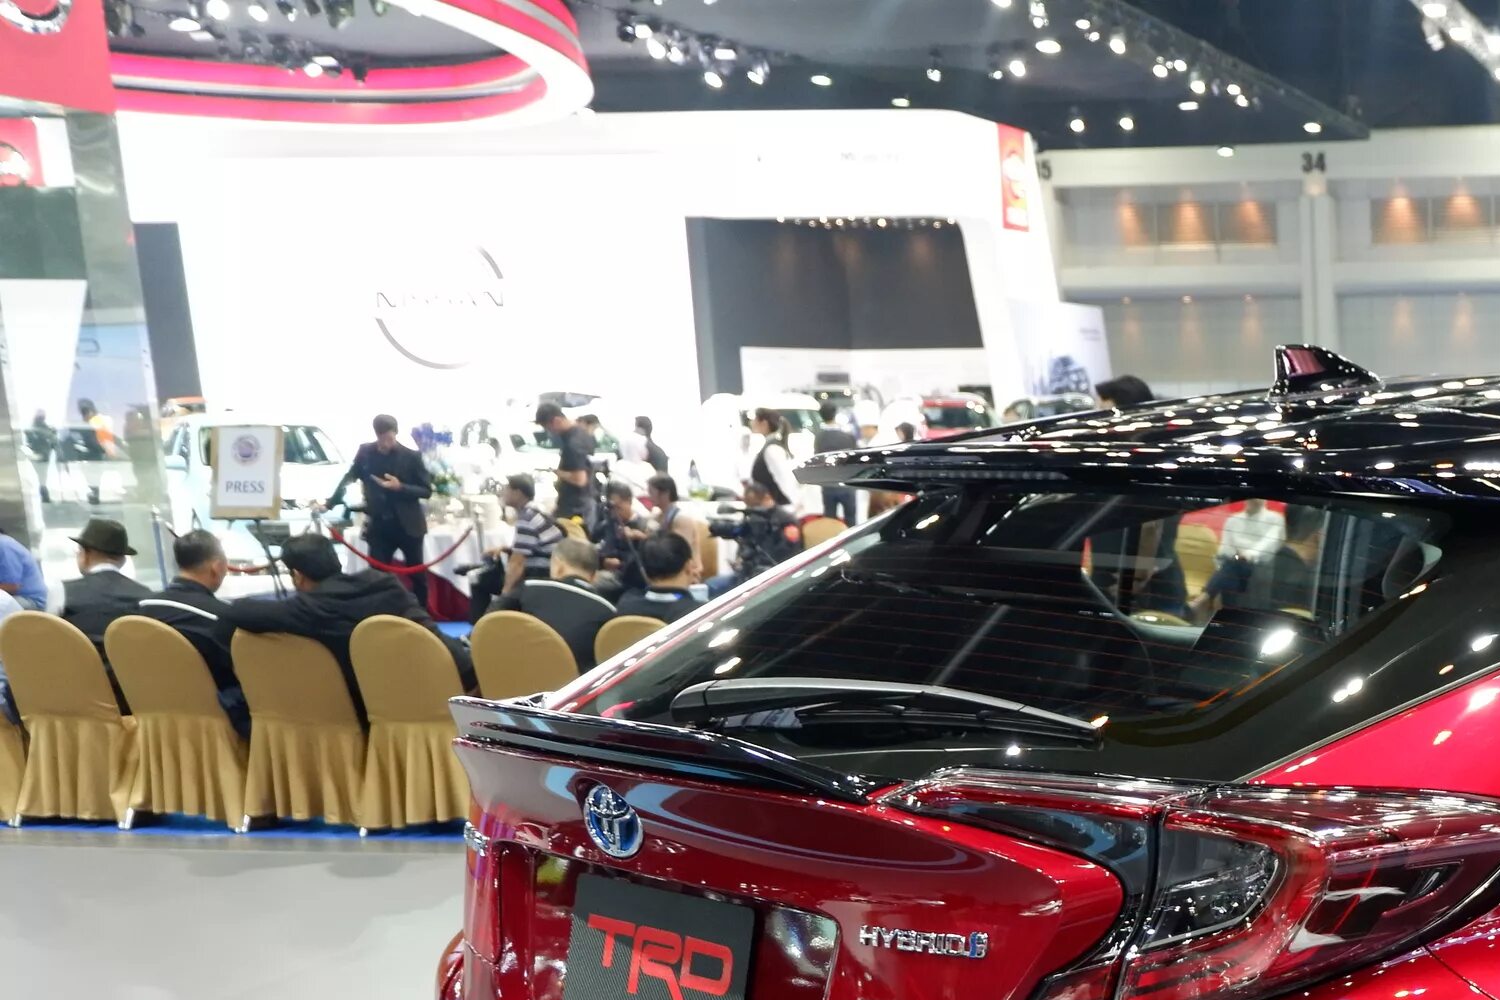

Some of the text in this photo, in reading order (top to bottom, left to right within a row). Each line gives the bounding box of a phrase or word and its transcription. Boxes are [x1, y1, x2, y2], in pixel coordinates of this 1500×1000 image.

[1301, 151, 1327, 174] 34
[225, 480, 265, 495] PRESS
[859, 924, 967, 957] HYBRID
